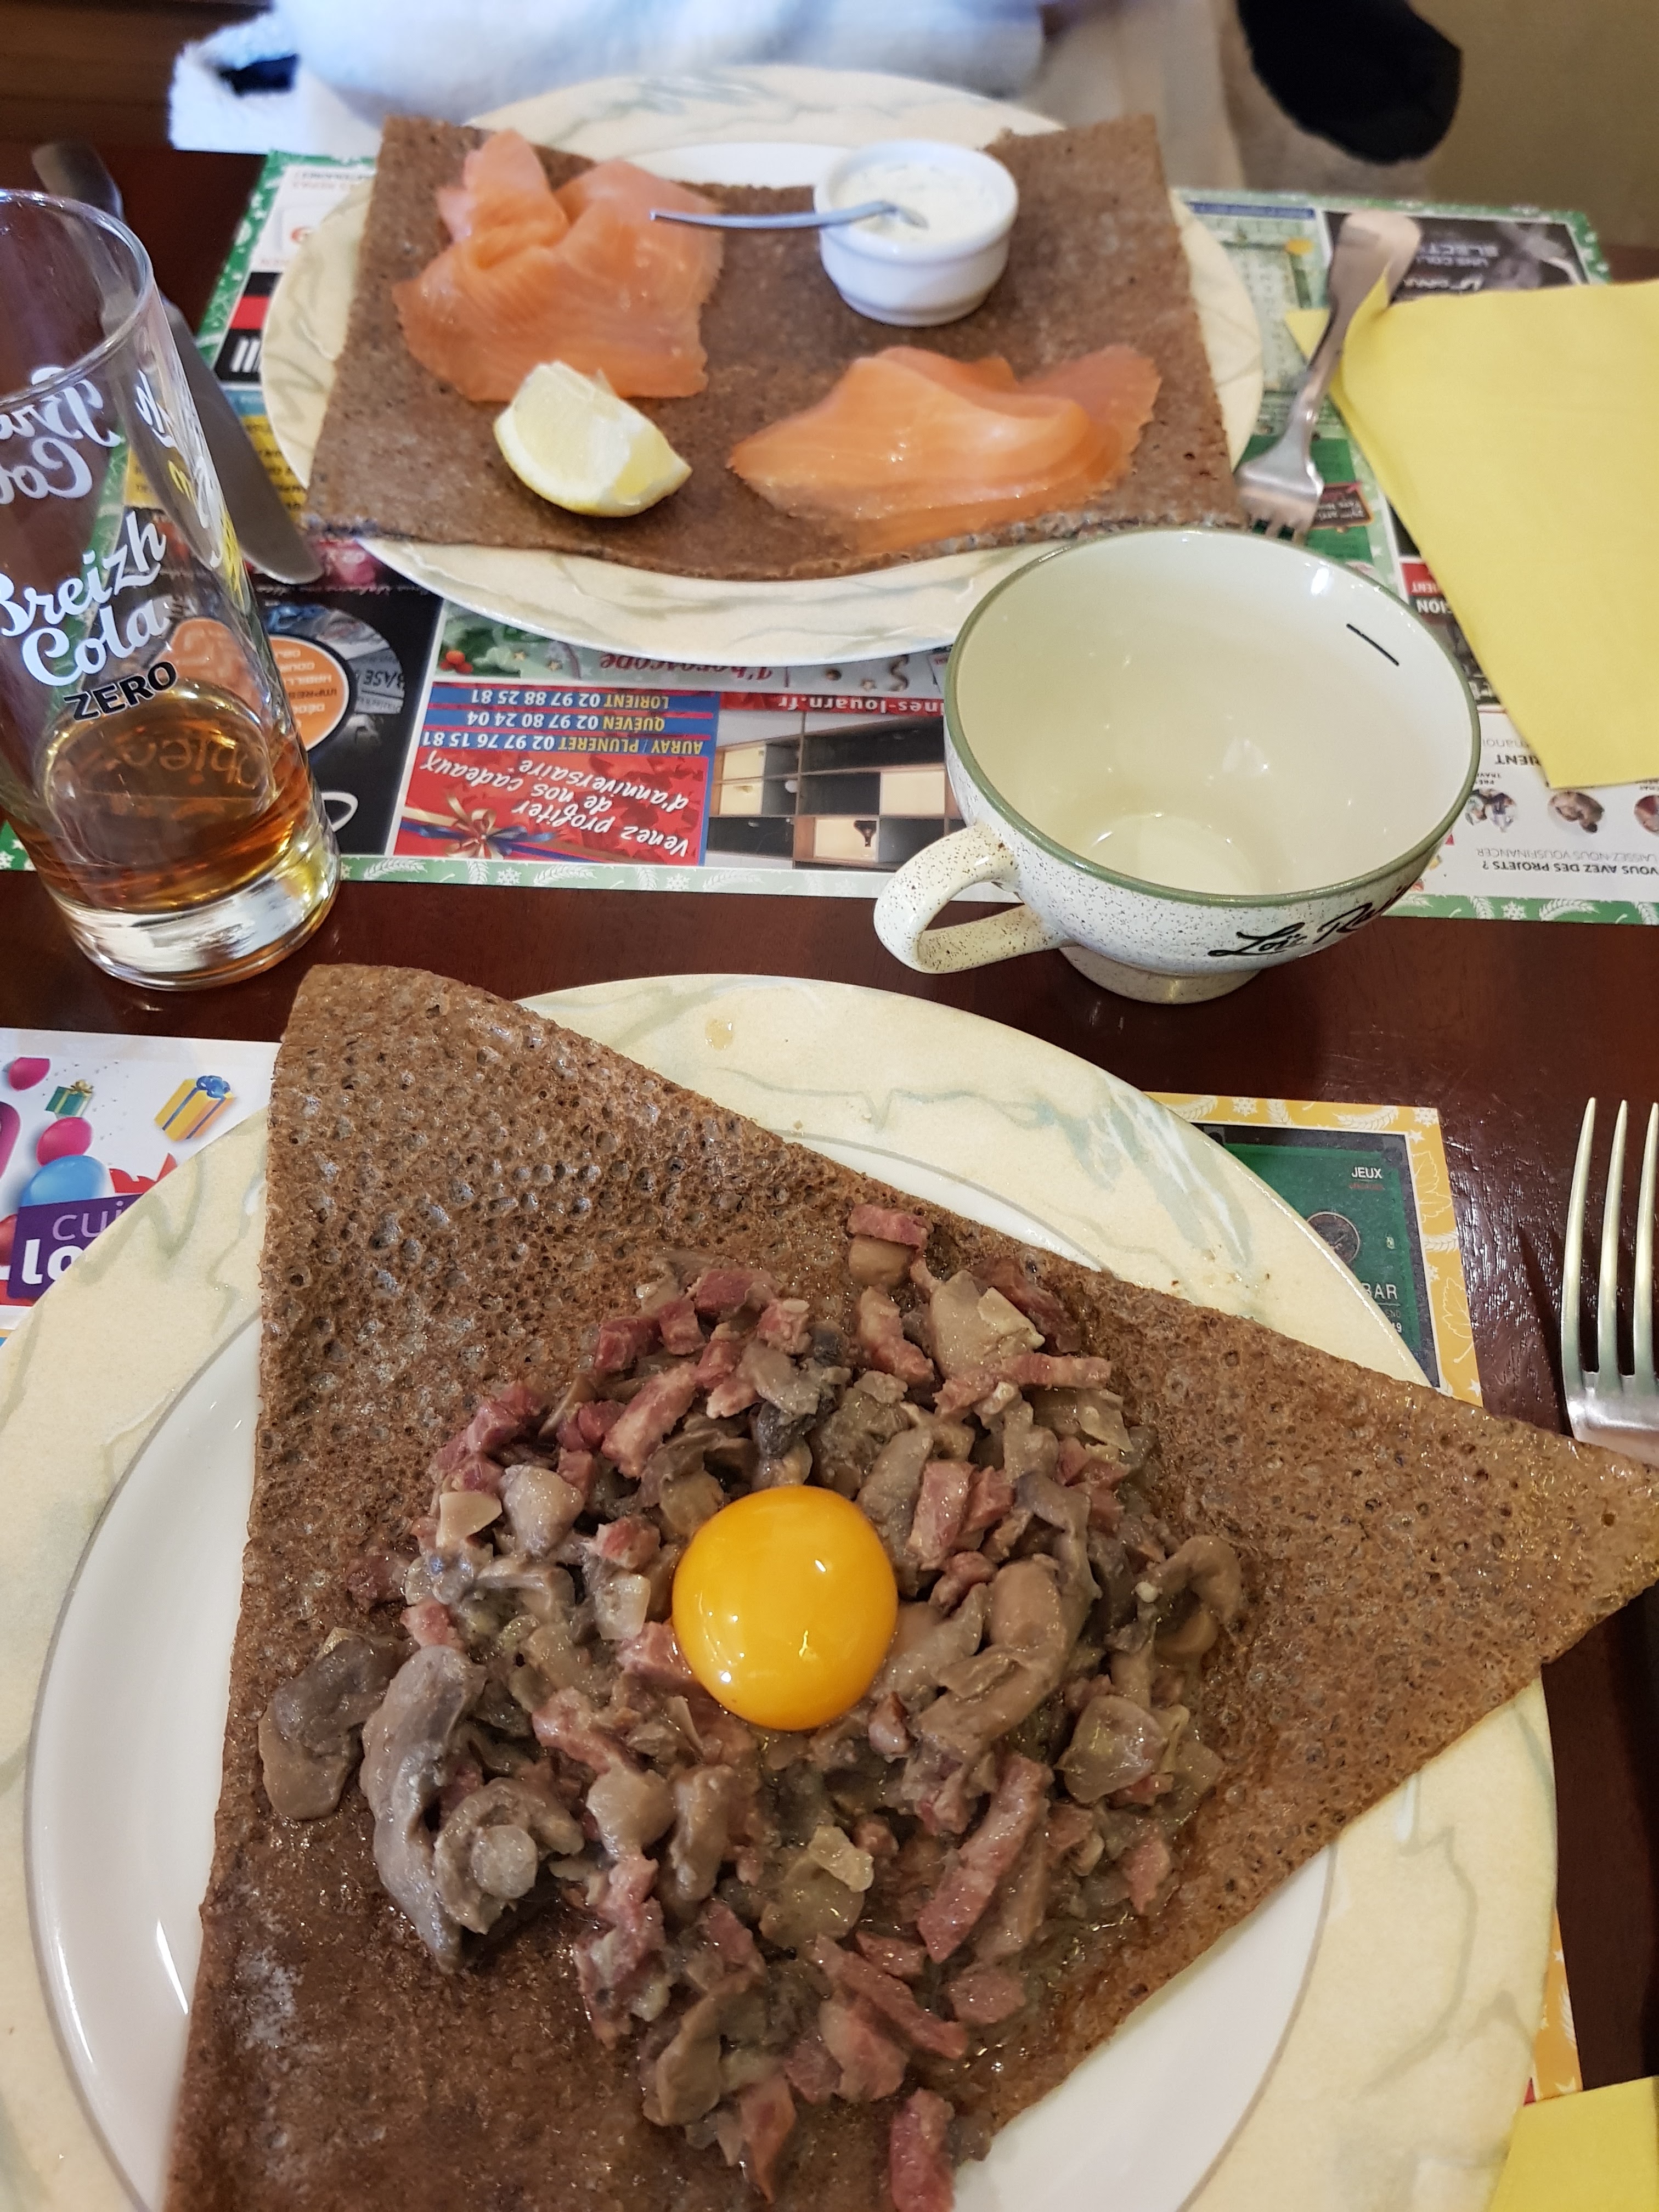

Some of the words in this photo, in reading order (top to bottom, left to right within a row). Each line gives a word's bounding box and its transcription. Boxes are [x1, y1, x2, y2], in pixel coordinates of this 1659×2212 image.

[22, 598, 171, 686] Cola
[64, 662, 177, 721] ZERO
[471, 690, 494, 704] 81
[498, 690, 520, 705] 25
[524, 691, 547, 706] 88
[551, 692, 573, 707] 97
[578, 692, 601, 708] 02
[604, 693, 669, 709] LORIENT
[467, 711, 490, 726] 04
[494, 712, 517, 727] 24
[522, 713, 544, 728] 80
[549, 714, 571, 729] 97
[576, 714, 599, 729] 02
[603, 715, 665, 733] QUÉVEN
[422, 731, 445, 747] 81
[450, 732, 471, 747] 15
[477, 733, 499, 749] 76
[504, 734, 527, 749] 97
[532, 735, 555, 751] 02
[557, 736, 639, 753] PLUNERET
[651, 739, 703, 754] AURAY
[419, 750, 523, 792] cadeaux
[529, 783, 574, 805] nos
[586, 794, 612, 814] de
[510, 800, 616, 834] profiter
[619, 825, 689, 857] Venez
[1492, 861, 1549, 871] PROJETS
[1553, 863, 1579, 872] DES
[1583, 865, 1617, 874] AVEZ
[1622, 866, 1658, 875] VOUS
[1351, 1166, 1383, 1179] JEUX
